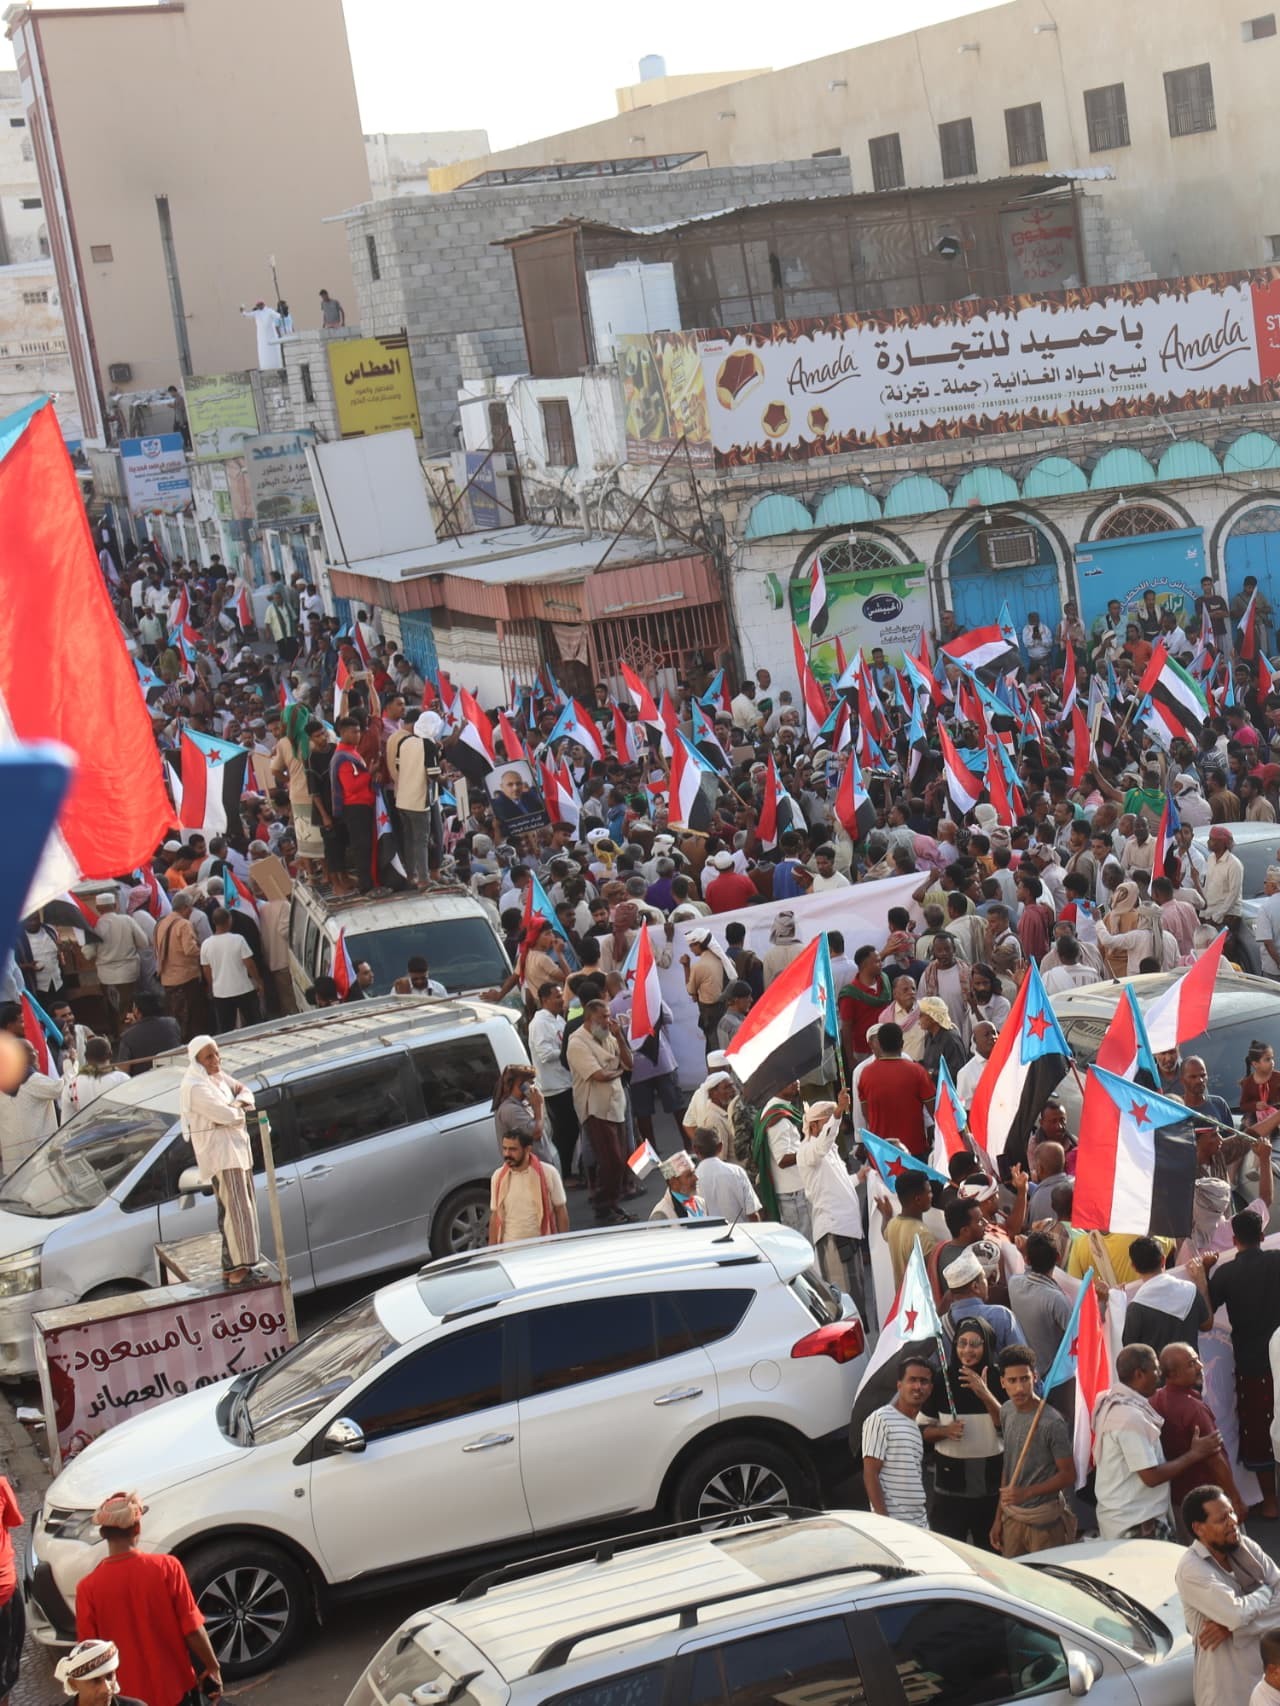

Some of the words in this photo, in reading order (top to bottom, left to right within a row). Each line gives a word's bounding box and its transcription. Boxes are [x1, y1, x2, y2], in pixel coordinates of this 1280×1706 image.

[875, 329, 1010, 375] للتجارة
[1021, 315, 1144, 359] باحميد
[1160, 308, 1251, 373] Amada
[344, 358, 400, 385] العطاس
[787, 344, 861, 395] Amada
[993, 367, 1060, 392] الغذائية
[1064, 362, 1104, 384] المواد
[1110, 357, 1147, 382] لبيع
[74, 1314, 202, 1372] بامسعود
[212, 1304, 288, 1343] بوفية
[88, 1372, 188, 1418] والعصائر
